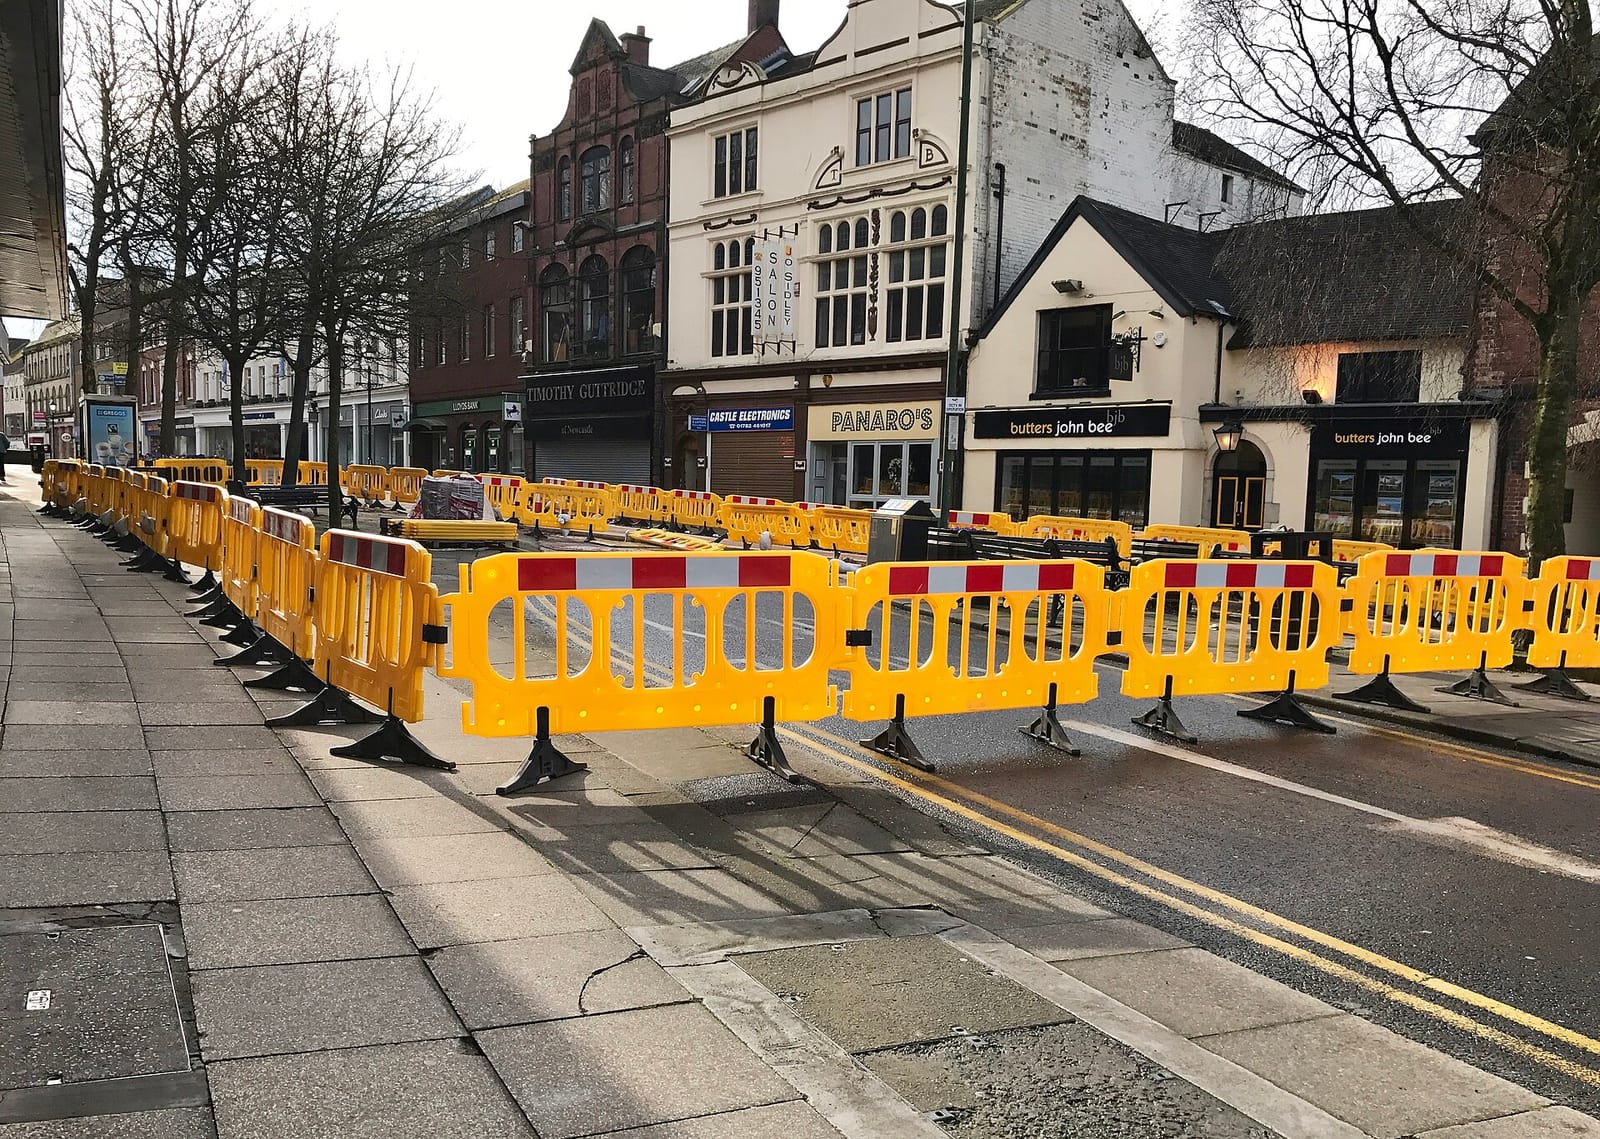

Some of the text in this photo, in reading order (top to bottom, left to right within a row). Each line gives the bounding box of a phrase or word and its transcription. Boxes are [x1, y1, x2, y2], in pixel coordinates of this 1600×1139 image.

[754, 265, 762, 330] 951345
[768, 252, 778, 327] SALON
[784, 272, 793, 326] SIDLEY
[526, 380, 646, 402] TIMOTHY GUTTRIDGE
[709, 409, 791, 422] CASTLE ELECTRONICS
[831, 407, 933, 432] PANARO'S
[1106, 409, 1126, 426] bjb
[1010, 420, 1113, 436] butters john bee
[1334, 432, 1432, 446] butters john bee
